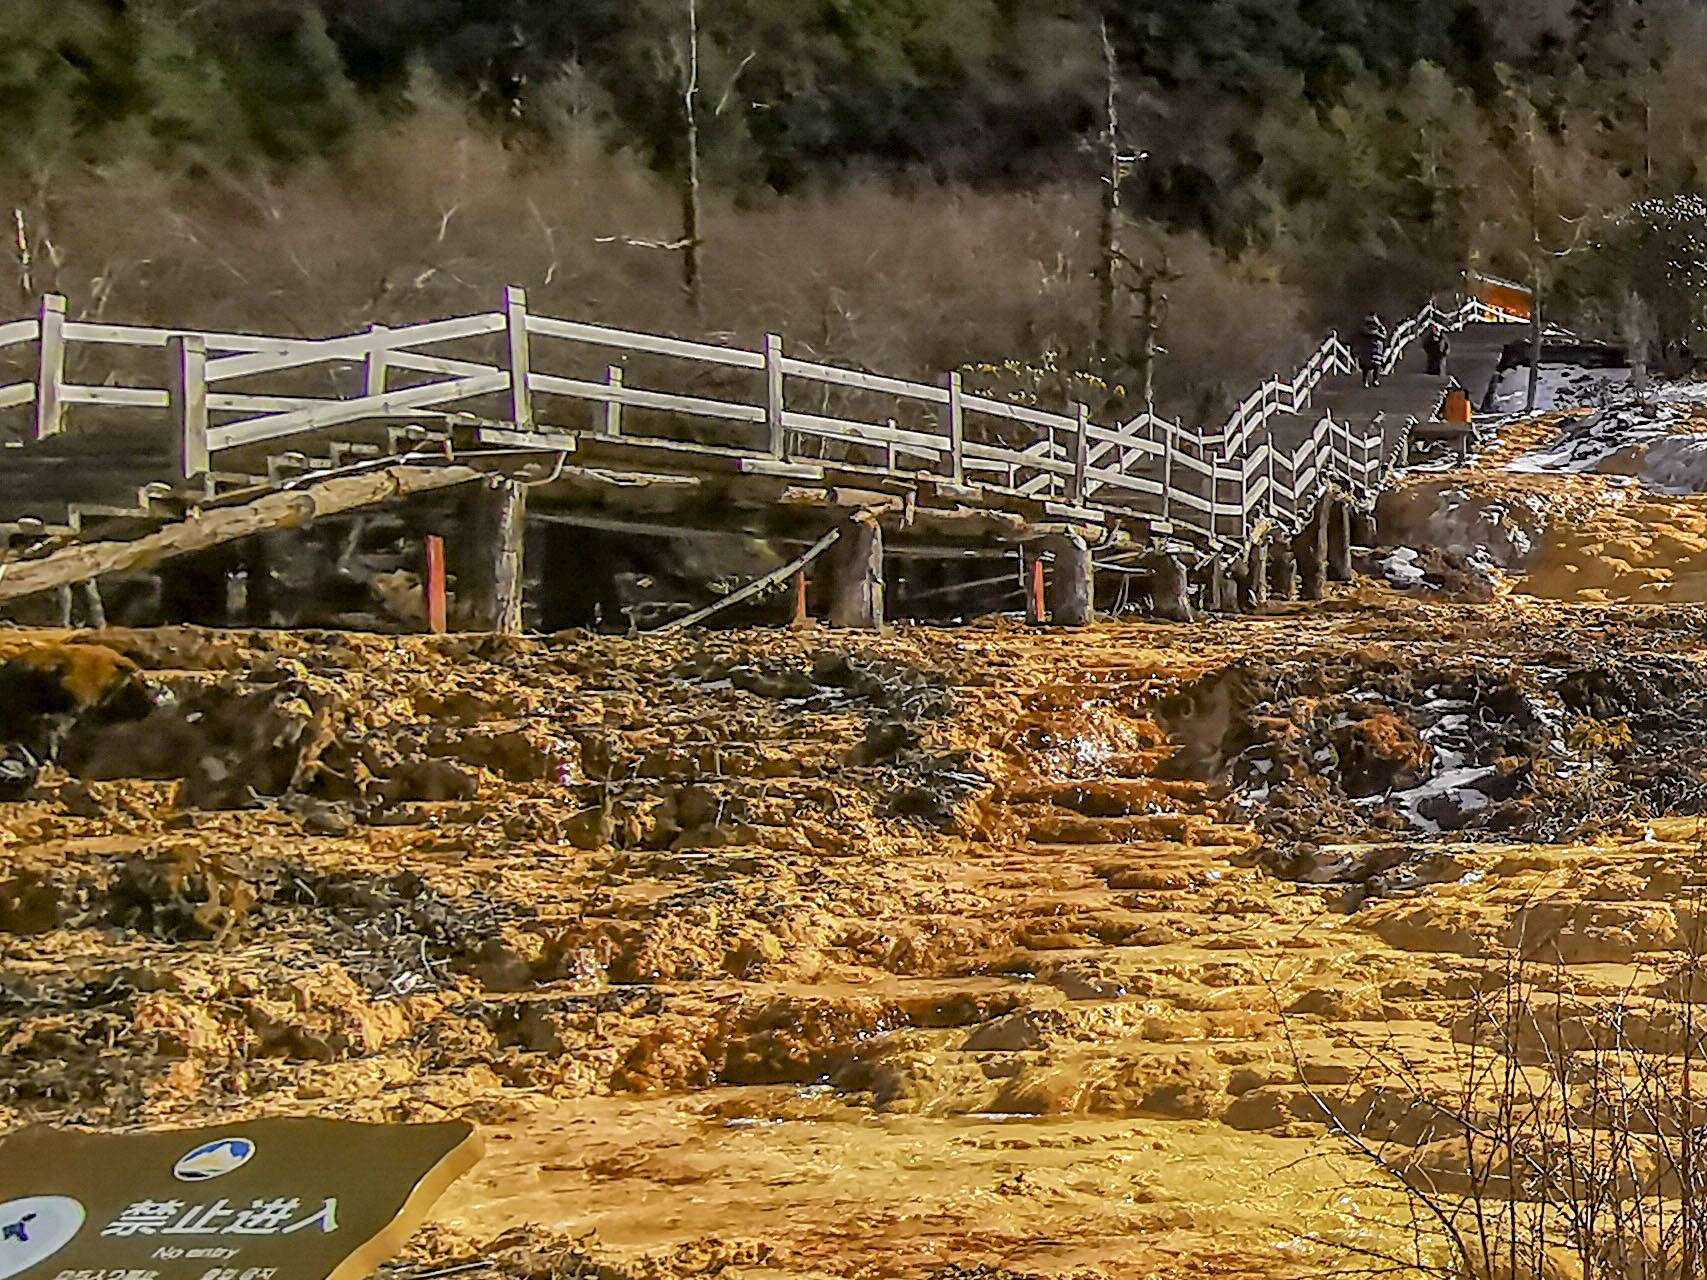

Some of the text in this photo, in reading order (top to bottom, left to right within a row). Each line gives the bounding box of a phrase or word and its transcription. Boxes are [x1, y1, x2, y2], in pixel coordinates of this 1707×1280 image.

[101, 1197, 339, 1236] 禁止进入
[151, 1246, 183, 1260] No
